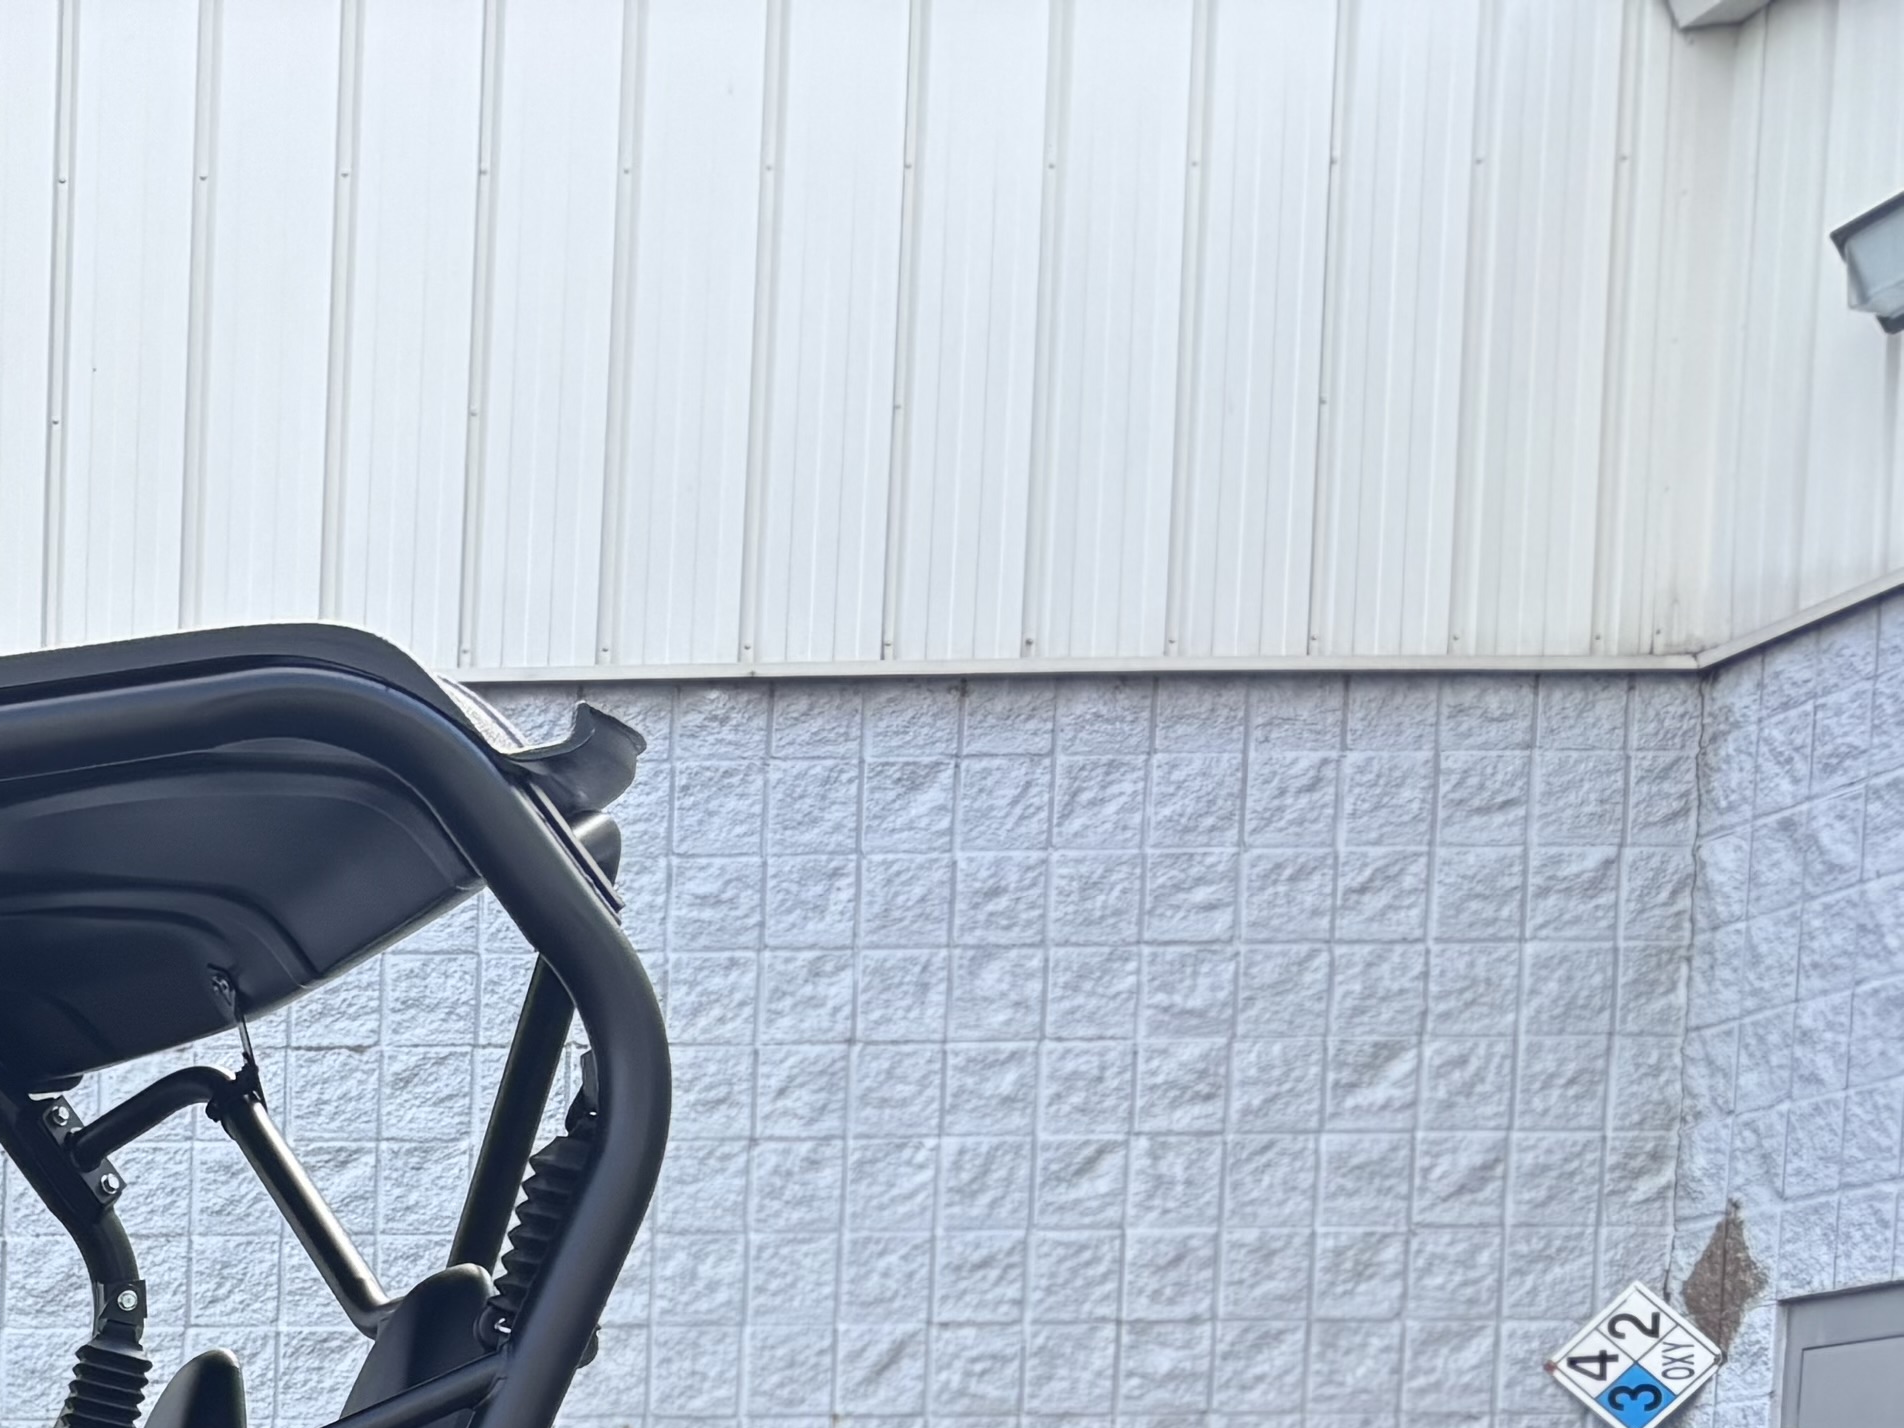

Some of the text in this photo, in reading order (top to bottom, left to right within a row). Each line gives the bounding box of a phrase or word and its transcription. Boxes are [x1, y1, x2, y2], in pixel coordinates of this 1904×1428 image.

[1607, 1311, 1661, 1340] 2
[1566, 1349, 1619, 1382] 4
[1661, 1340, 1695, 1381] OXY
[1607, 1383, 1663, 1412] 3
